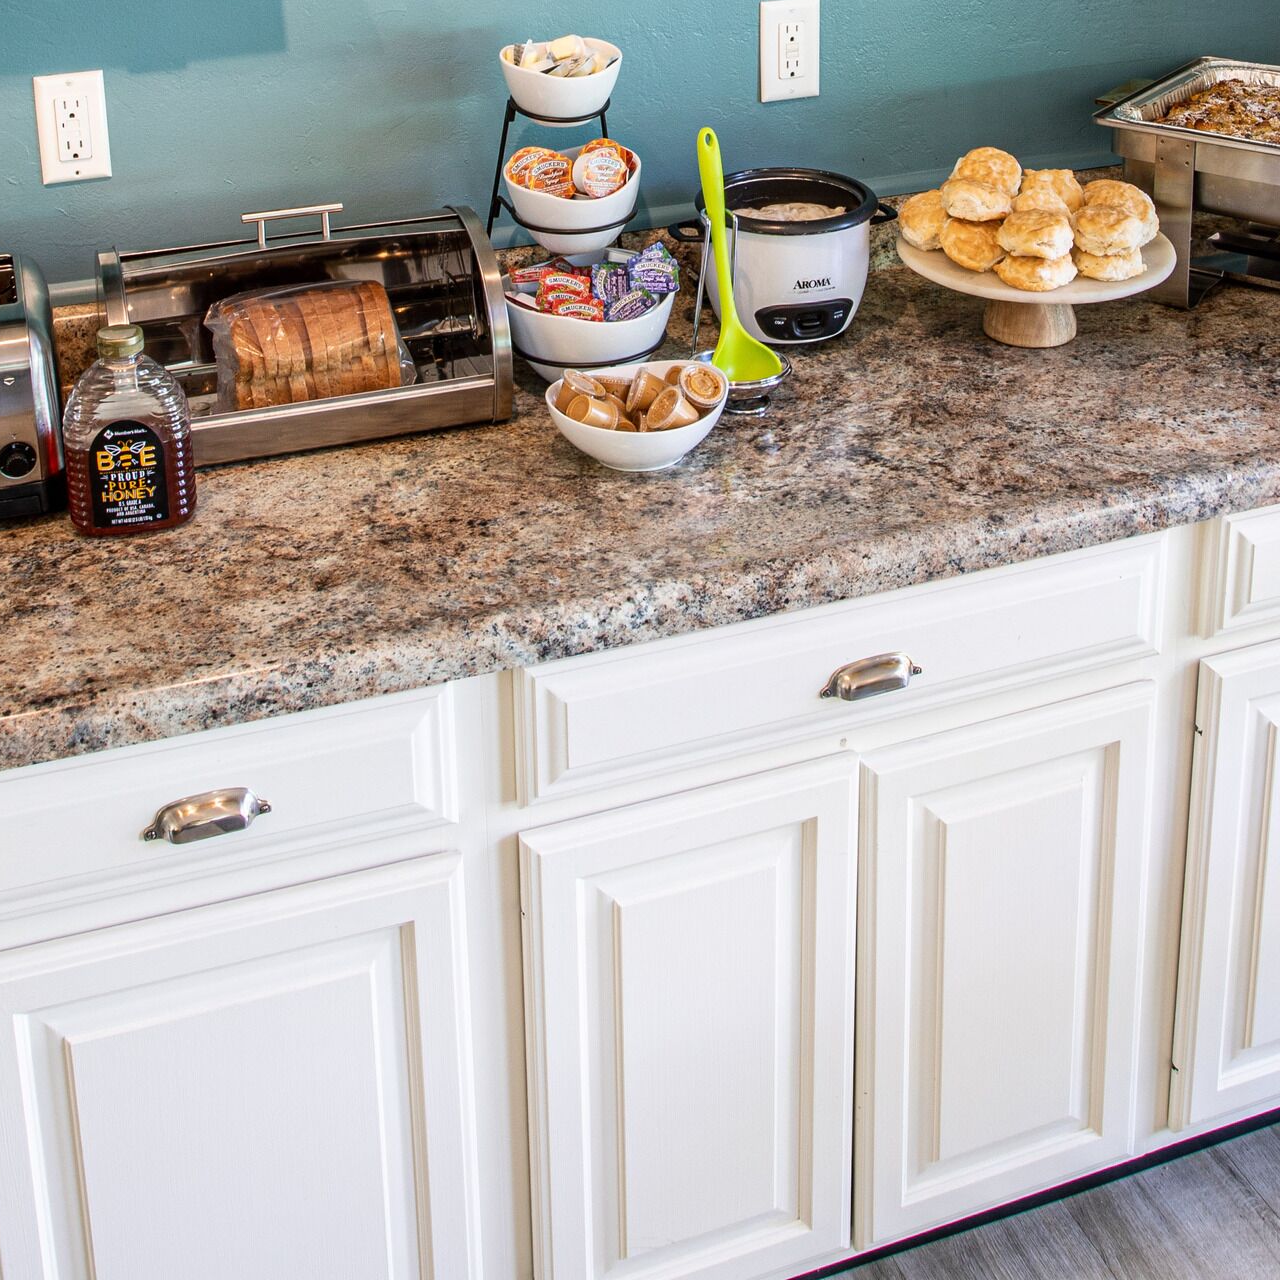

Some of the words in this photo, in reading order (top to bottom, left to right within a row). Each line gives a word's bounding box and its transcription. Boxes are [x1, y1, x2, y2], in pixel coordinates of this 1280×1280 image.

[793, 278, 831, 290] AROMA
[110, 470, 146, 481] PROUD
[108, 478, 147, 491] PURE
[101, 485, 157, 503] HONEY
